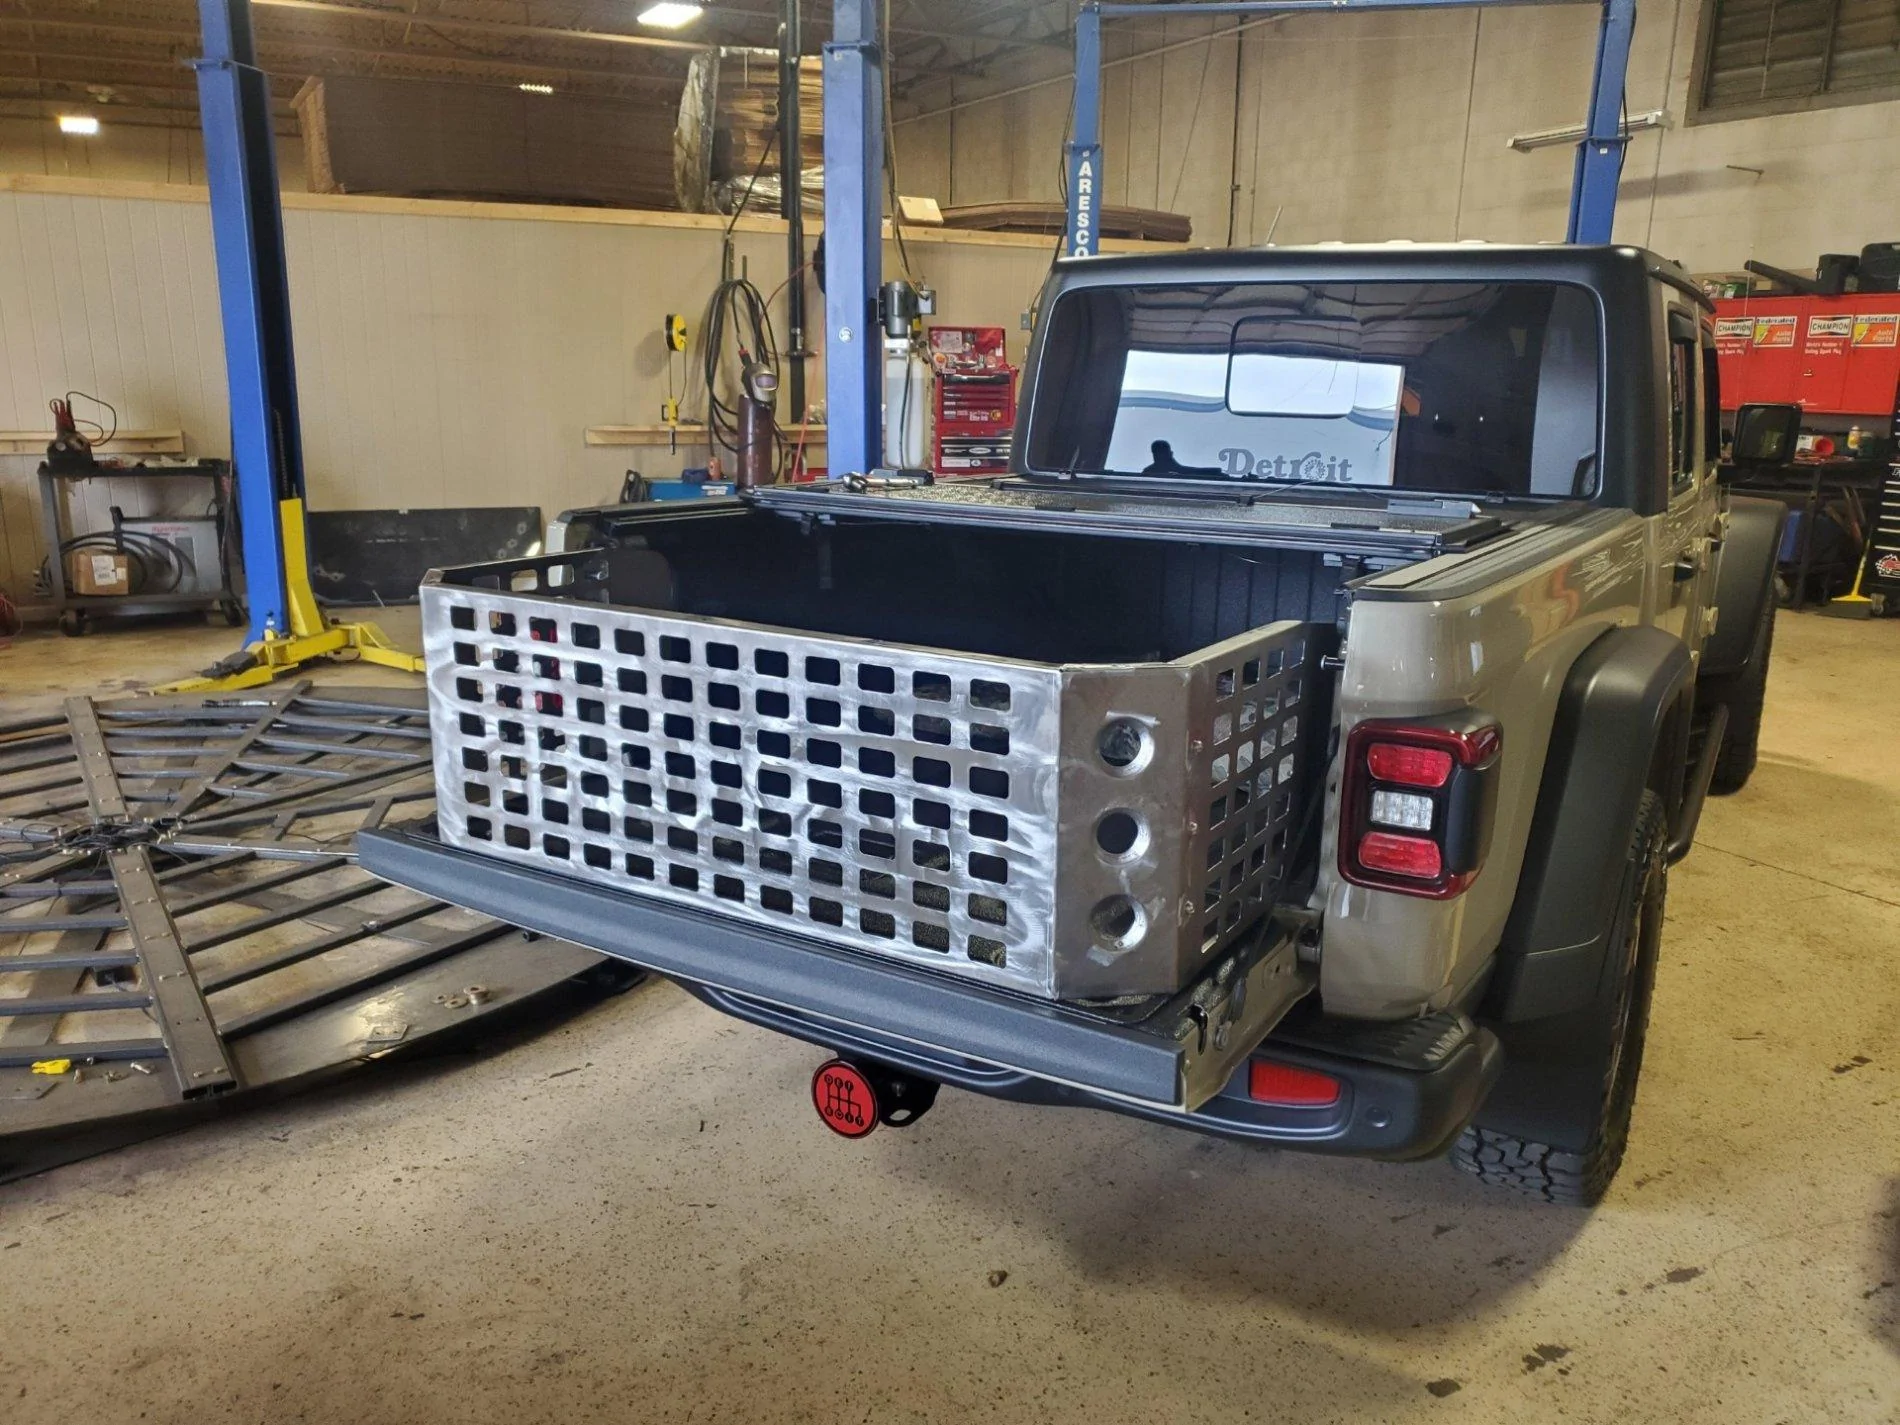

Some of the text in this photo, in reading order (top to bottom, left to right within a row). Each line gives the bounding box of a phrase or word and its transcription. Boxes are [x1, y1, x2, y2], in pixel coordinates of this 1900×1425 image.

[1718, 324, 1751, 332] CHAMPION
[1812, 323, 1848, 331] CHAMPION
[1218, 447, 1353, 482] Detroit
